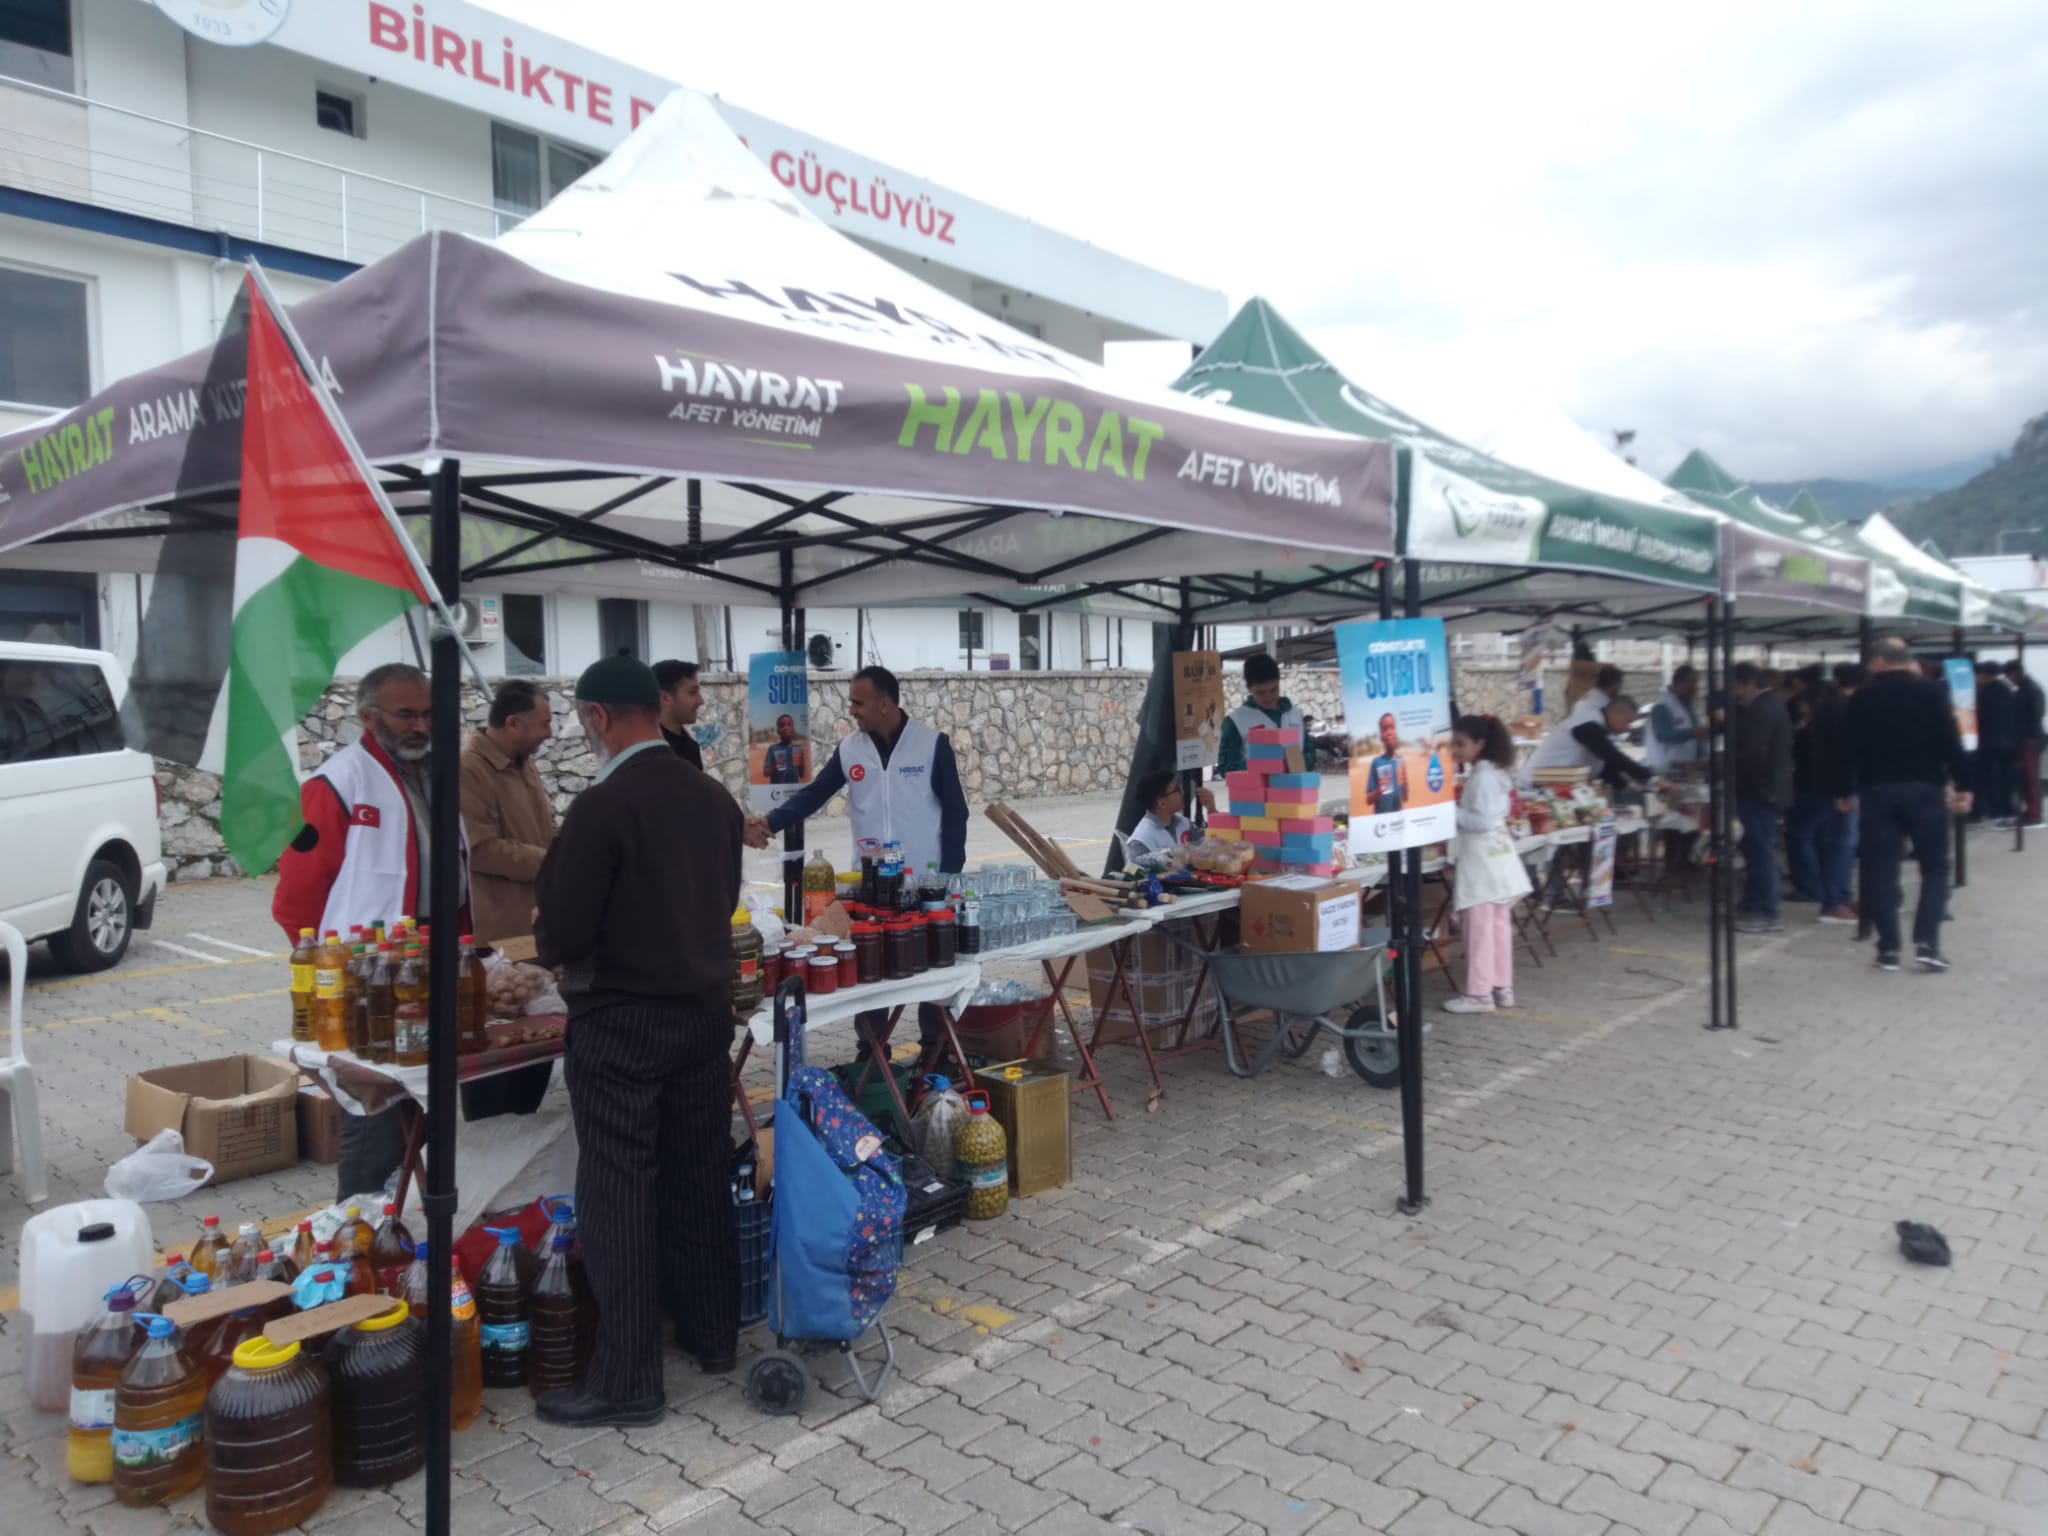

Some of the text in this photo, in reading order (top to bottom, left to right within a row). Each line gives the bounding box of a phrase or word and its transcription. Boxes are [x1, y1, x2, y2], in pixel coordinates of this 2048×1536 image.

[369, 1, 613, 126] BİRLİKTE
[770, 150, 956, 245] GÜÇLÜYÜZ
[654, 355, 844, 413] HAYRAT
[668, 402, 822, 437] AFET YÖNETİMİ
[19, 407, 115, 494] HAYRAT
[128, 388, 206, 445] ARAMA
[898, 383, 1342, 507] HAYRAT AFET YÖNETİMİ
